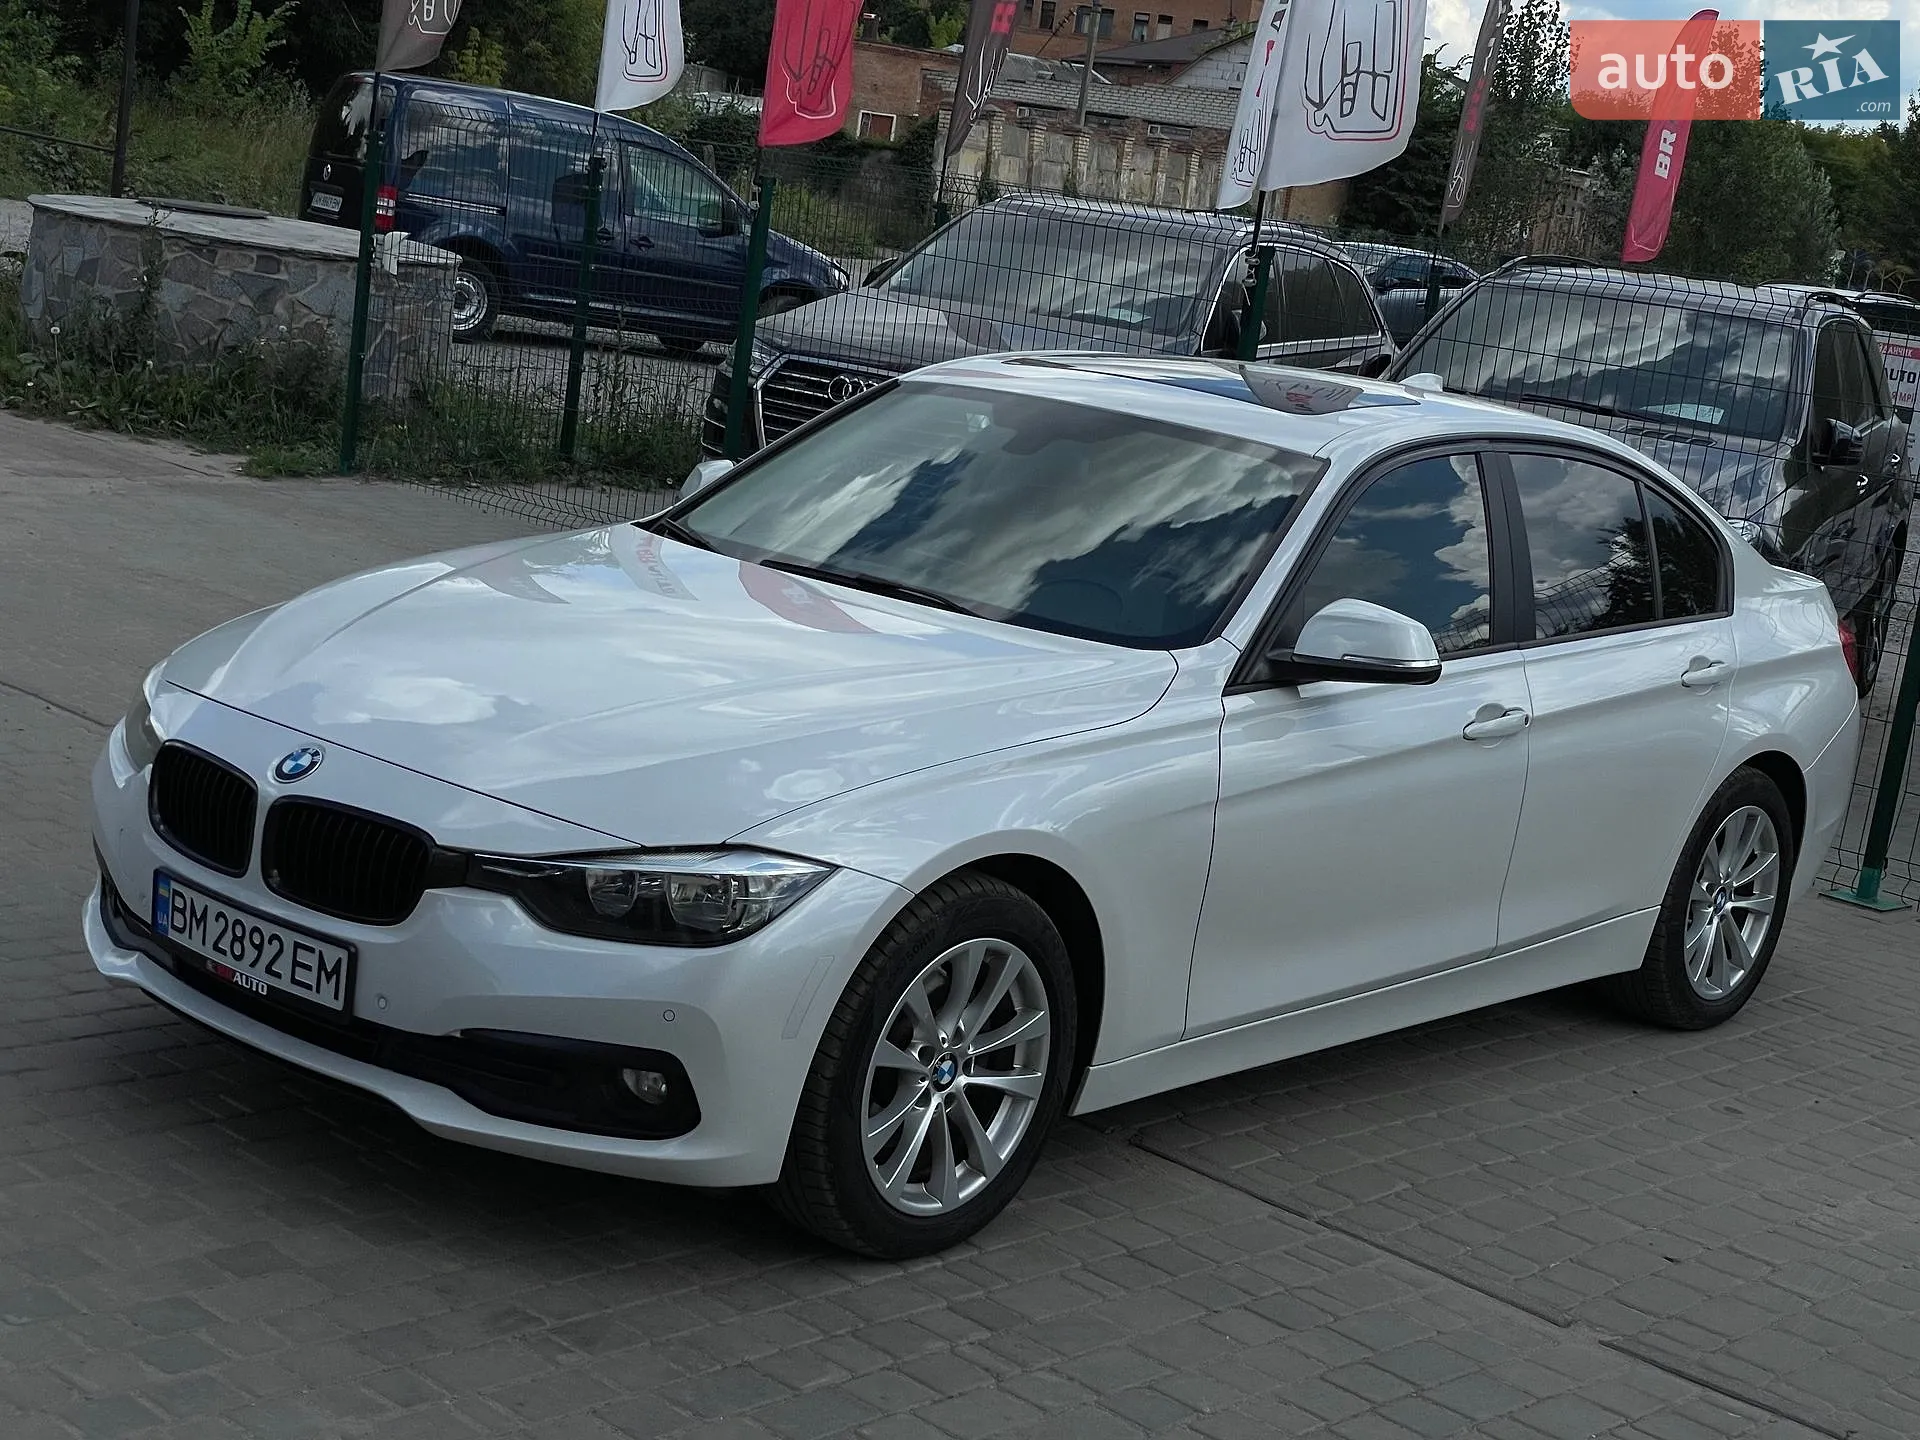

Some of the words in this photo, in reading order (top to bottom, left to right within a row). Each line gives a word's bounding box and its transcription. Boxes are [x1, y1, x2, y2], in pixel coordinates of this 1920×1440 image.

[156, 910, 168, 927] UA
[170, 888, 209, 946] BM
[212, 910, 285, 980] 2892
[290, 940, 342, 1001] EM
